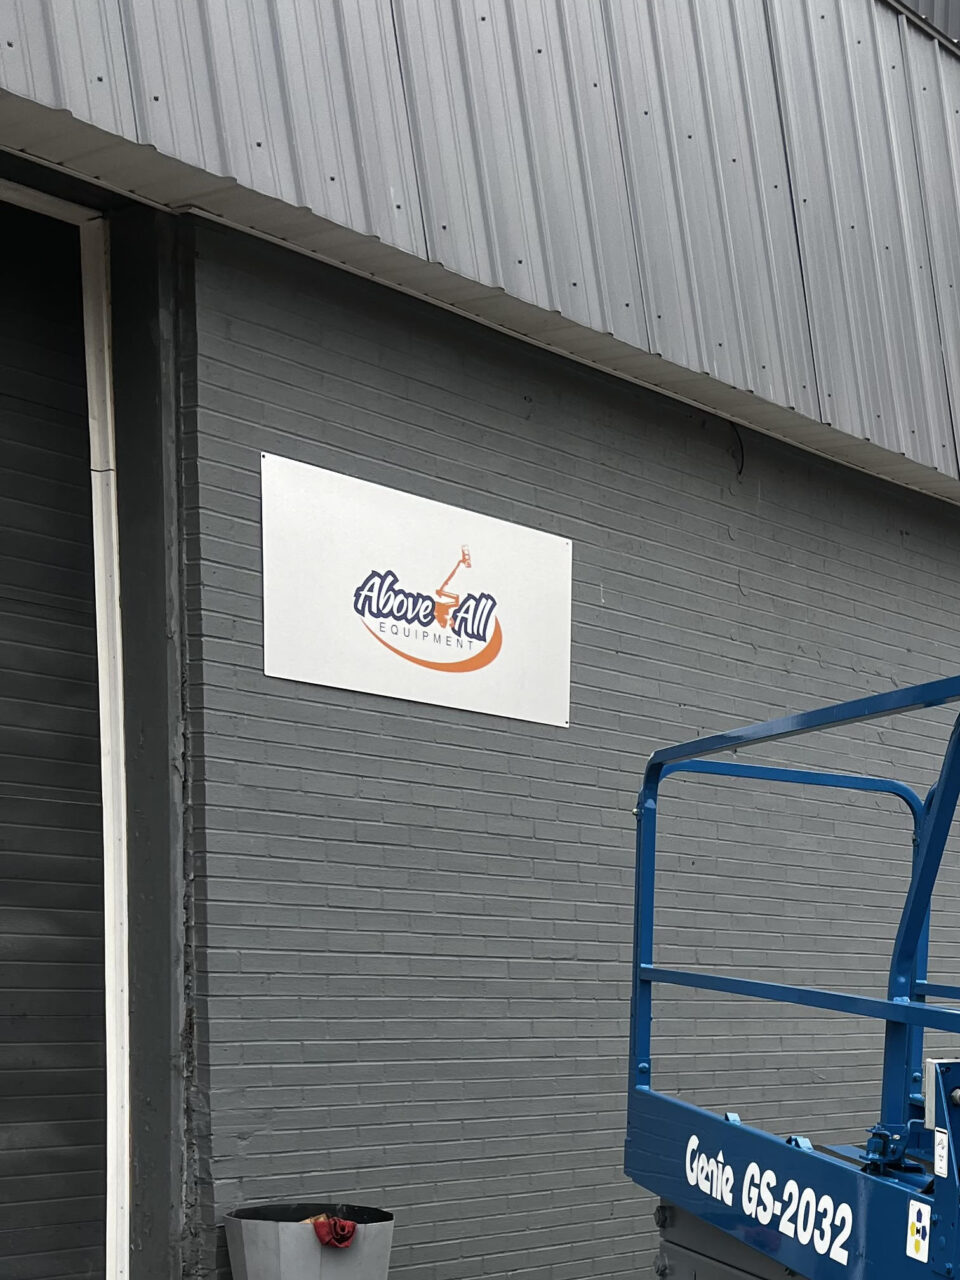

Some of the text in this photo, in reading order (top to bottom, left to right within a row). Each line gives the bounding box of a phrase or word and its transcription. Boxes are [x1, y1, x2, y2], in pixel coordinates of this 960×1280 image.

[355, 571, 496, 642] Above All
[379, 622, 473, 650] EQUIPMENT
[686, 1135, 852, 1266] Genie GS-2032
